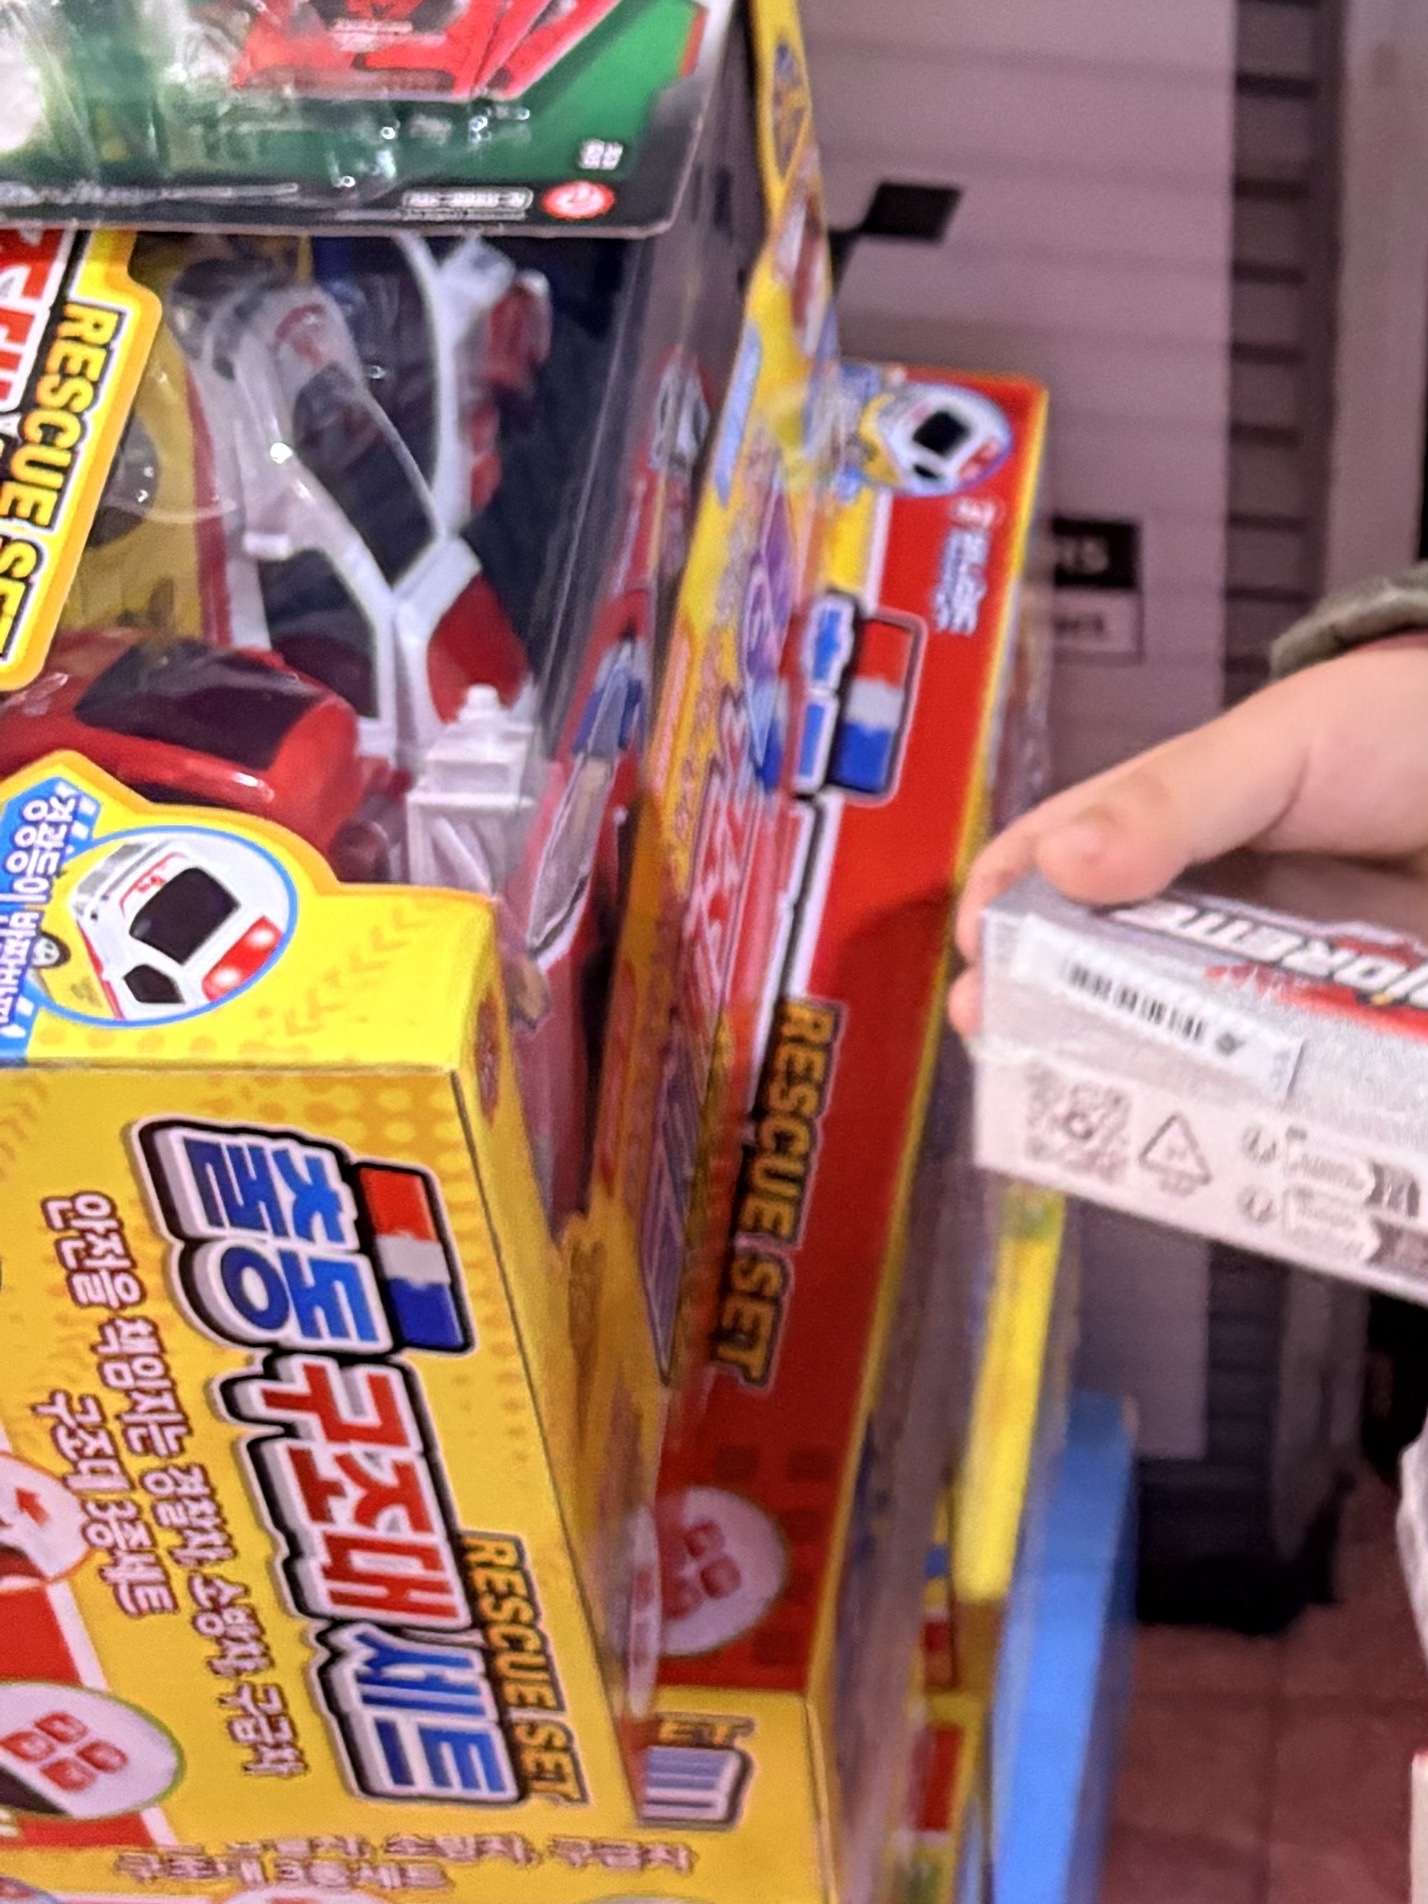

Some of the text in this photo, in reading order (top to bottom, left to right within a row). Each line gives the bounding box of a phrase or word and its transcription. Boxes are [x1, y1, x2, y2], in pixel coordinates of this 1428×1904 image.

[0, 302, 118, 527] RESCUE
[717, 1004, 837, 1387] RESCUE SET
[32, 1389, 178, 1616] 구조대 3종세트
[43, 1192, 142, 1309] 안전을
[95, 1316, 191, 1458] 책임지는
[217, 1682, 308, 1778] 구급차
[182, 1137, 508, 1794] 출동 구조대 세트
[464, 1534, 586, 1804] RESCUE SET
